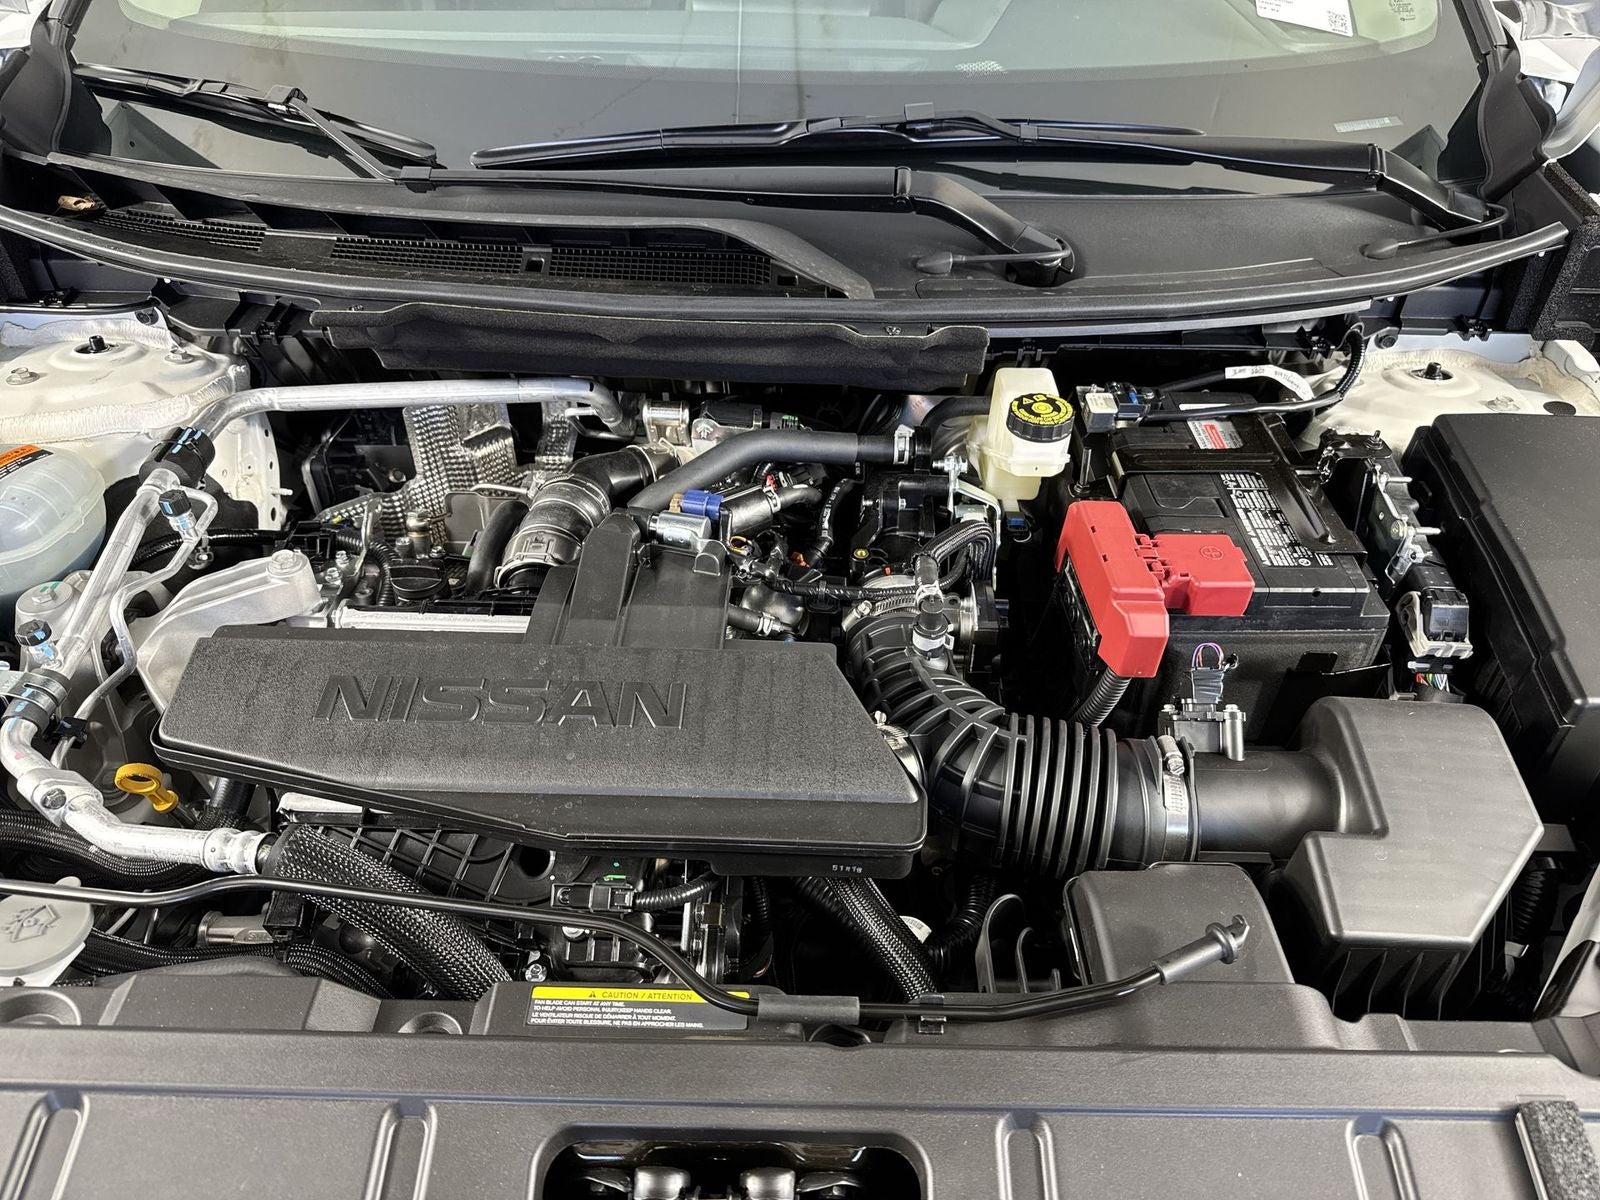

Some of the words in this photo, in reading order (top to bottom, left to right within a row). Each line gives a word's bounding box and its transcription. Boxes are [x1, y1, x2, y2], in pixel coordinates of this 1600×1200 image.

[312, 674, 687, 729] NISSAN
[601, 991, 639, 999] CAUTION
[647, 992, 693, 1000] ATTENTION
